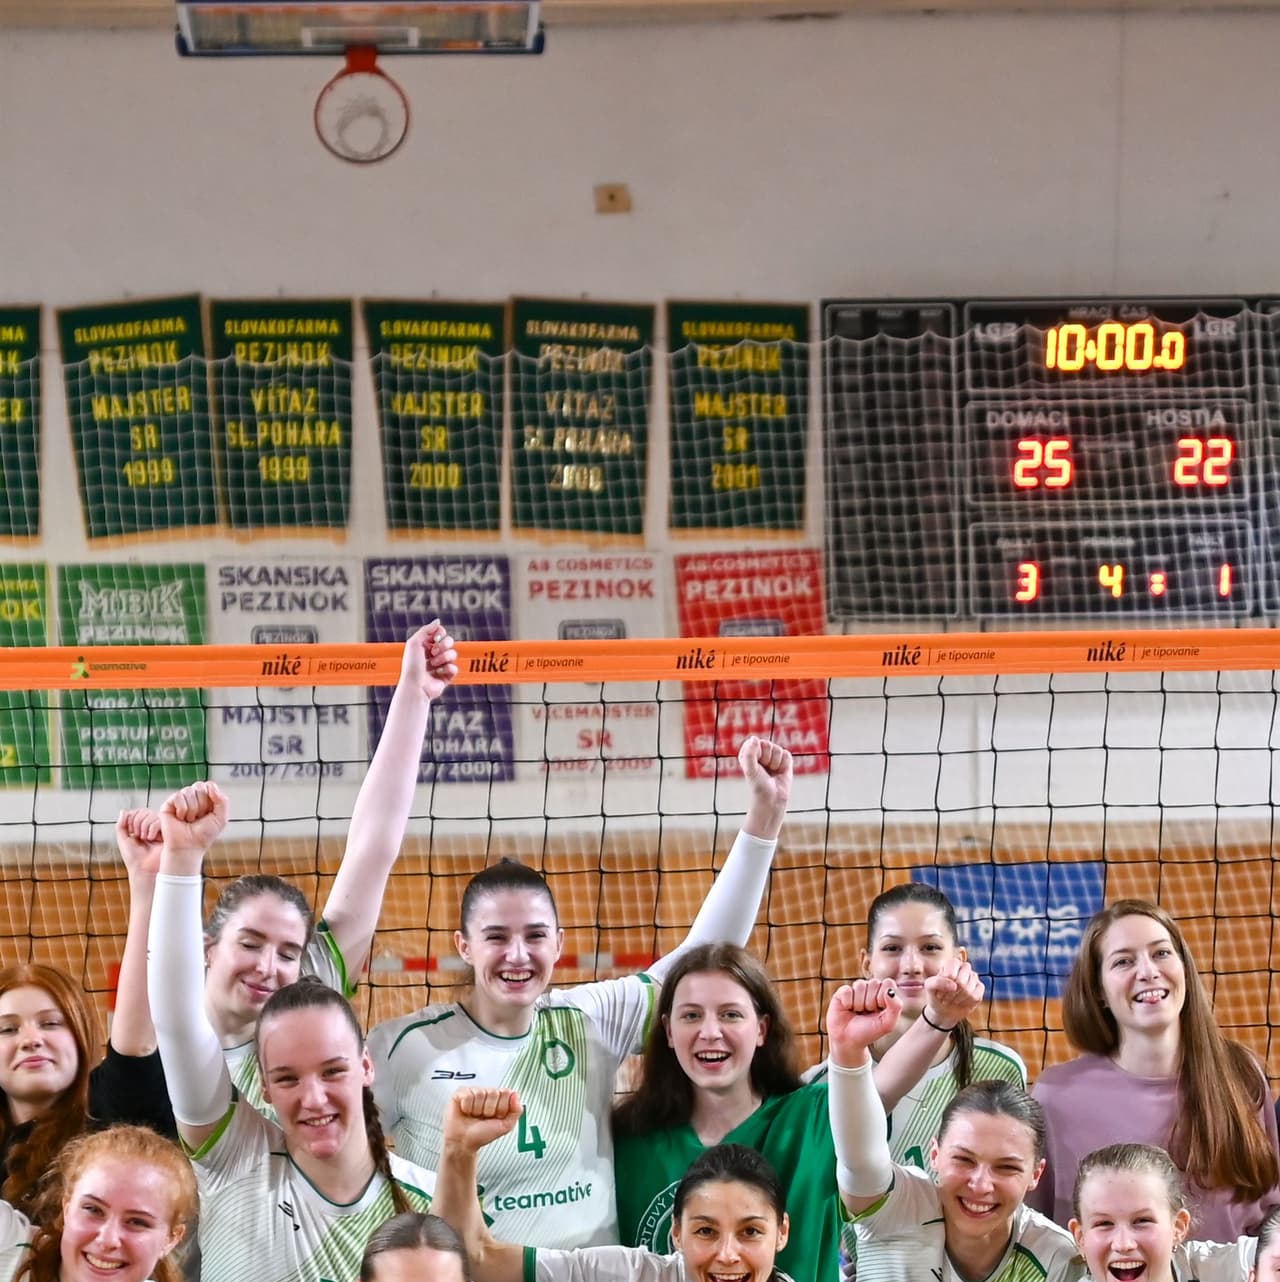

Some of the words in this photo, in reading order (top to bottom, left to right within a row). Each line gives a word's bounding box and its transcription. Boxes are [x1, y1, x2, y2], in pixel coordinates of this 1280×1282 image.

[74, 316, 187, 343] SLOVAKOFARMA
[224, 319, 340, 336] SLOVAKOFARMA
[380, 320, 492, 339] SLOVAKOFARMA
[526, 319, 640, 340] SLOVAKOFARMA
[682, 320, 795, 339] SLOVAKOFARMA
[88, 341, 180, 375] PEZINOK
[235, 341, 330, 367] PEZINOK
[390, 343, 479, 370] PEZINOK
[539, 344, 625, 372] PEZINOK
[697, 344, 781, 371] PEZINOK
[91, 387, 193, 421] MAJSTER
[391, 391, 484, 417] MAJSTER
[694, 392, 787, 418] MAJSTER
[986, 406, 1070, 428] DOMÁCI
[1146, 406, 1227, 427] HOSTIA
[130, 424, 160, 451] SR
[420, 425, 449, 452] SR
[723, 426, 748, 452] SR
[123, 457, 176, 487] 1999
[259, 455, 311, 481] 1999
[1014, 439, 1073, 488] 25
[1174, 437, 1233, 486] 22
[409, 463, 462, 489] 2000
[711, 463, 761, 491] 2001
[218, 566, 349, 586] SKANSKA
[372, 565, 501, 586] SKANSKA
[556, 558, 653, 571] COSMETICS
[528, 578, 654, 600] PEZINOK
[686, 576, 812, 600] PEZINOK
[1016, 562, 1039, 601] 3
[1099, 563, 1124, 598] 4
[1219, 563, 1231, 597] 1
[79, 580, 183, 618] MBK
[222, 591, 348, 612] PEZINOK
[374, 590, 501, 610] PEZINOK
[79, 624, 187, 644] PEZINOK
[469, 650, 509, 673] niké
[535, 656, 582, 669] tipovanie
[675, 647, 716, 670] niké
[743, 653, 791, 666] tipovanie
[881, 644, 922, 666] niké
[949, 649, 995, 662] tipovanie
[1086, 640, 1126, 662] niké
[1152, 645, 1197, 658] tipovanie
[261, 653, 302, 676] niké
[329, 659, 377, 672] tipovanie
[221, 706, 349, 724] MAJSTER
[80, 726, 154, 741] POSTUP
[160, 726, 188, 741] DO
[267, 735, 304, 755] SR
[577, 728, 613, 750] SR
[80, 746, 189, 761] EXTRALIGY
[229, 763, 344, 779] 2007/2008
[517, 1104, 547, 1159] 4
[494, 1181, 592, 1211] teamative
